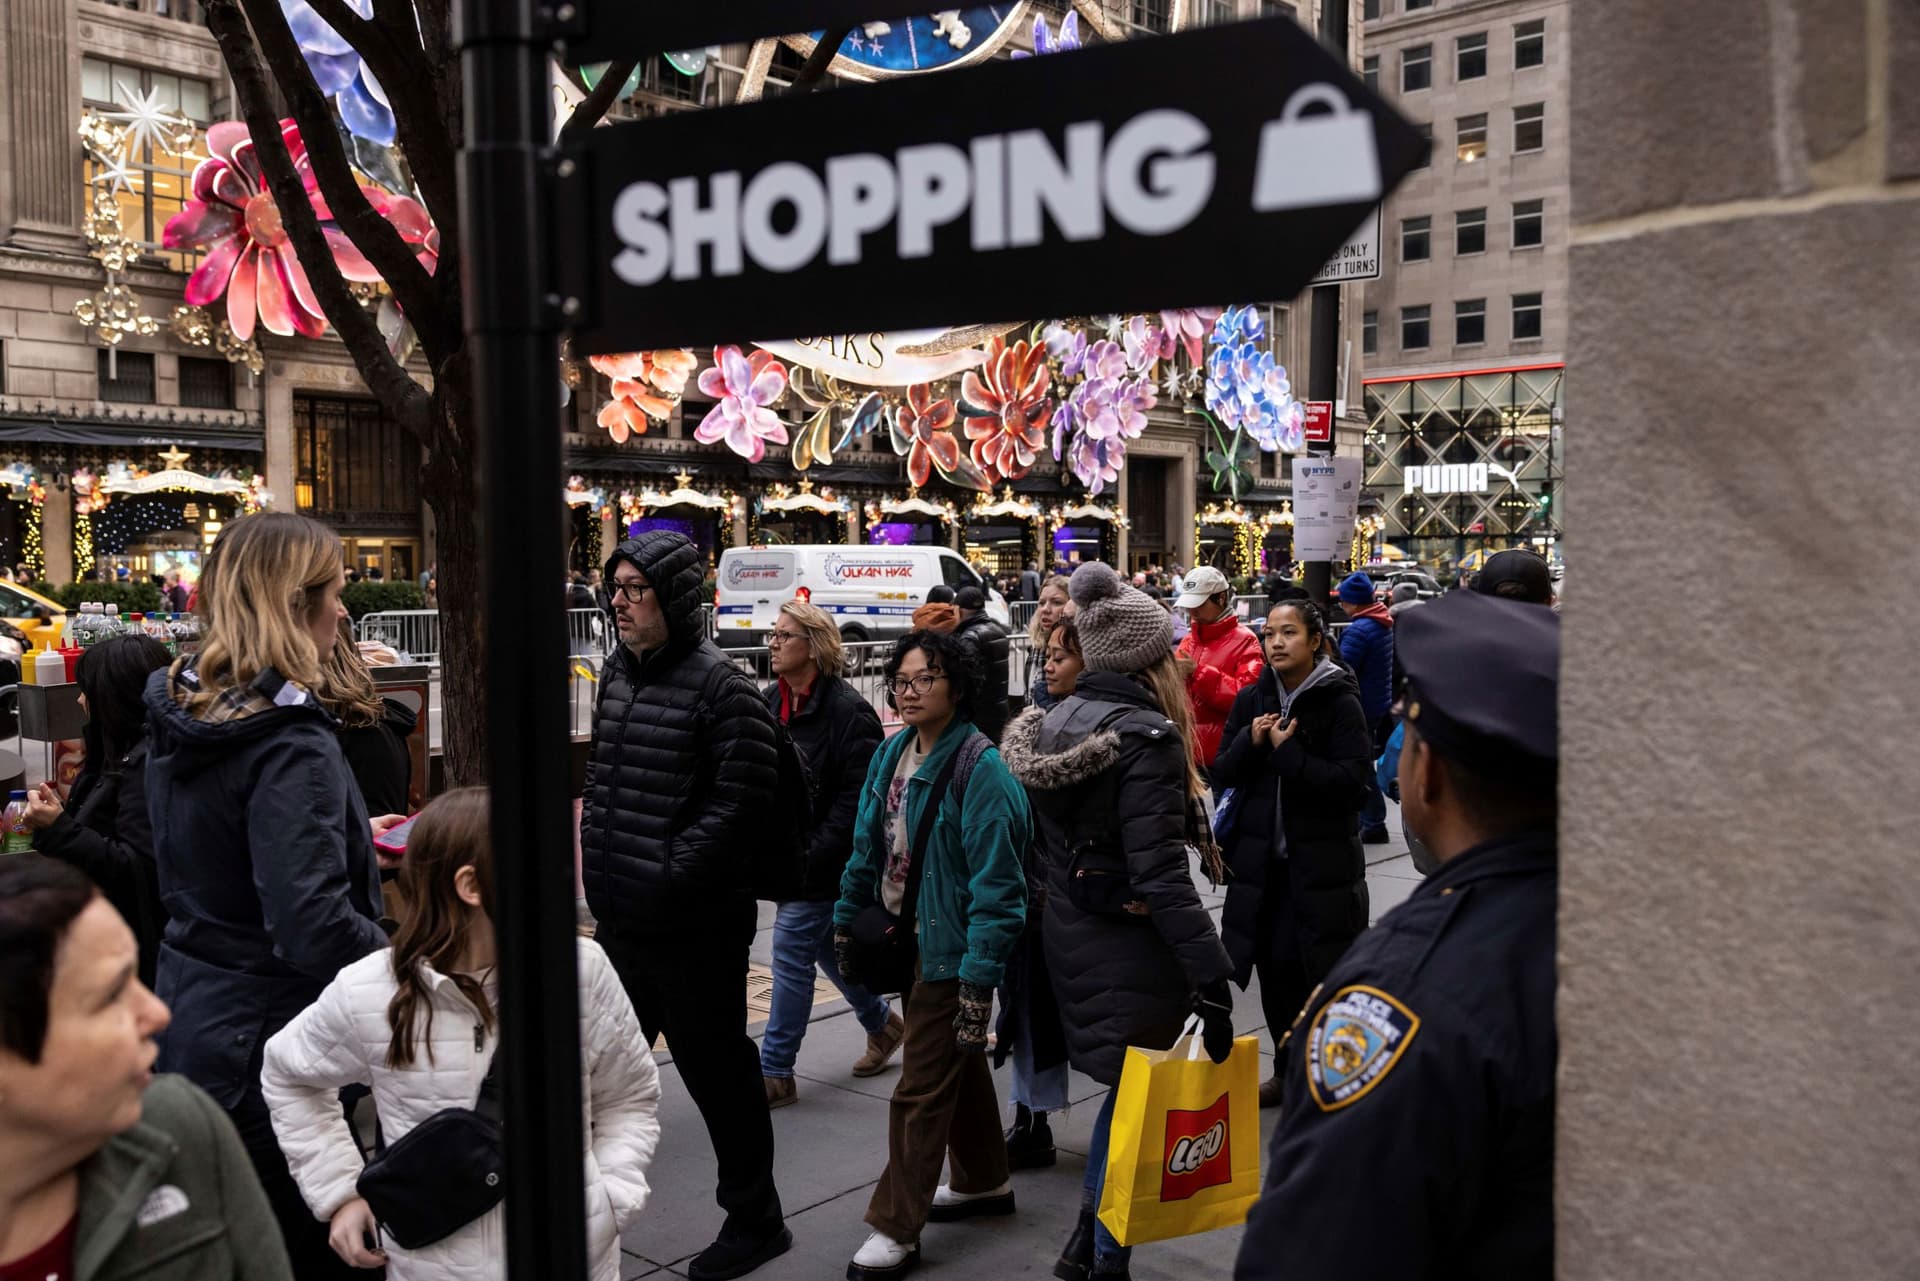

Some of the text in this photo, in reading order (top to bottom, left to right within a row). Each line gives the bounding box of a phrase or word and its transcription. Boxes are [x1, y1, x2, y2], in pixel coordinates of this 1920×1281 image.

[611, 108, 1217, 288] SHOPPING
[1343, 243, 1368, 258] ONLY
[1344, 259, 1375, 275] TURNS
[1404, 462, 1488, 494] PUMA
[885, 566, 913, 578] HVAC
[1169, 1121, 1225, 1174] LEGO
